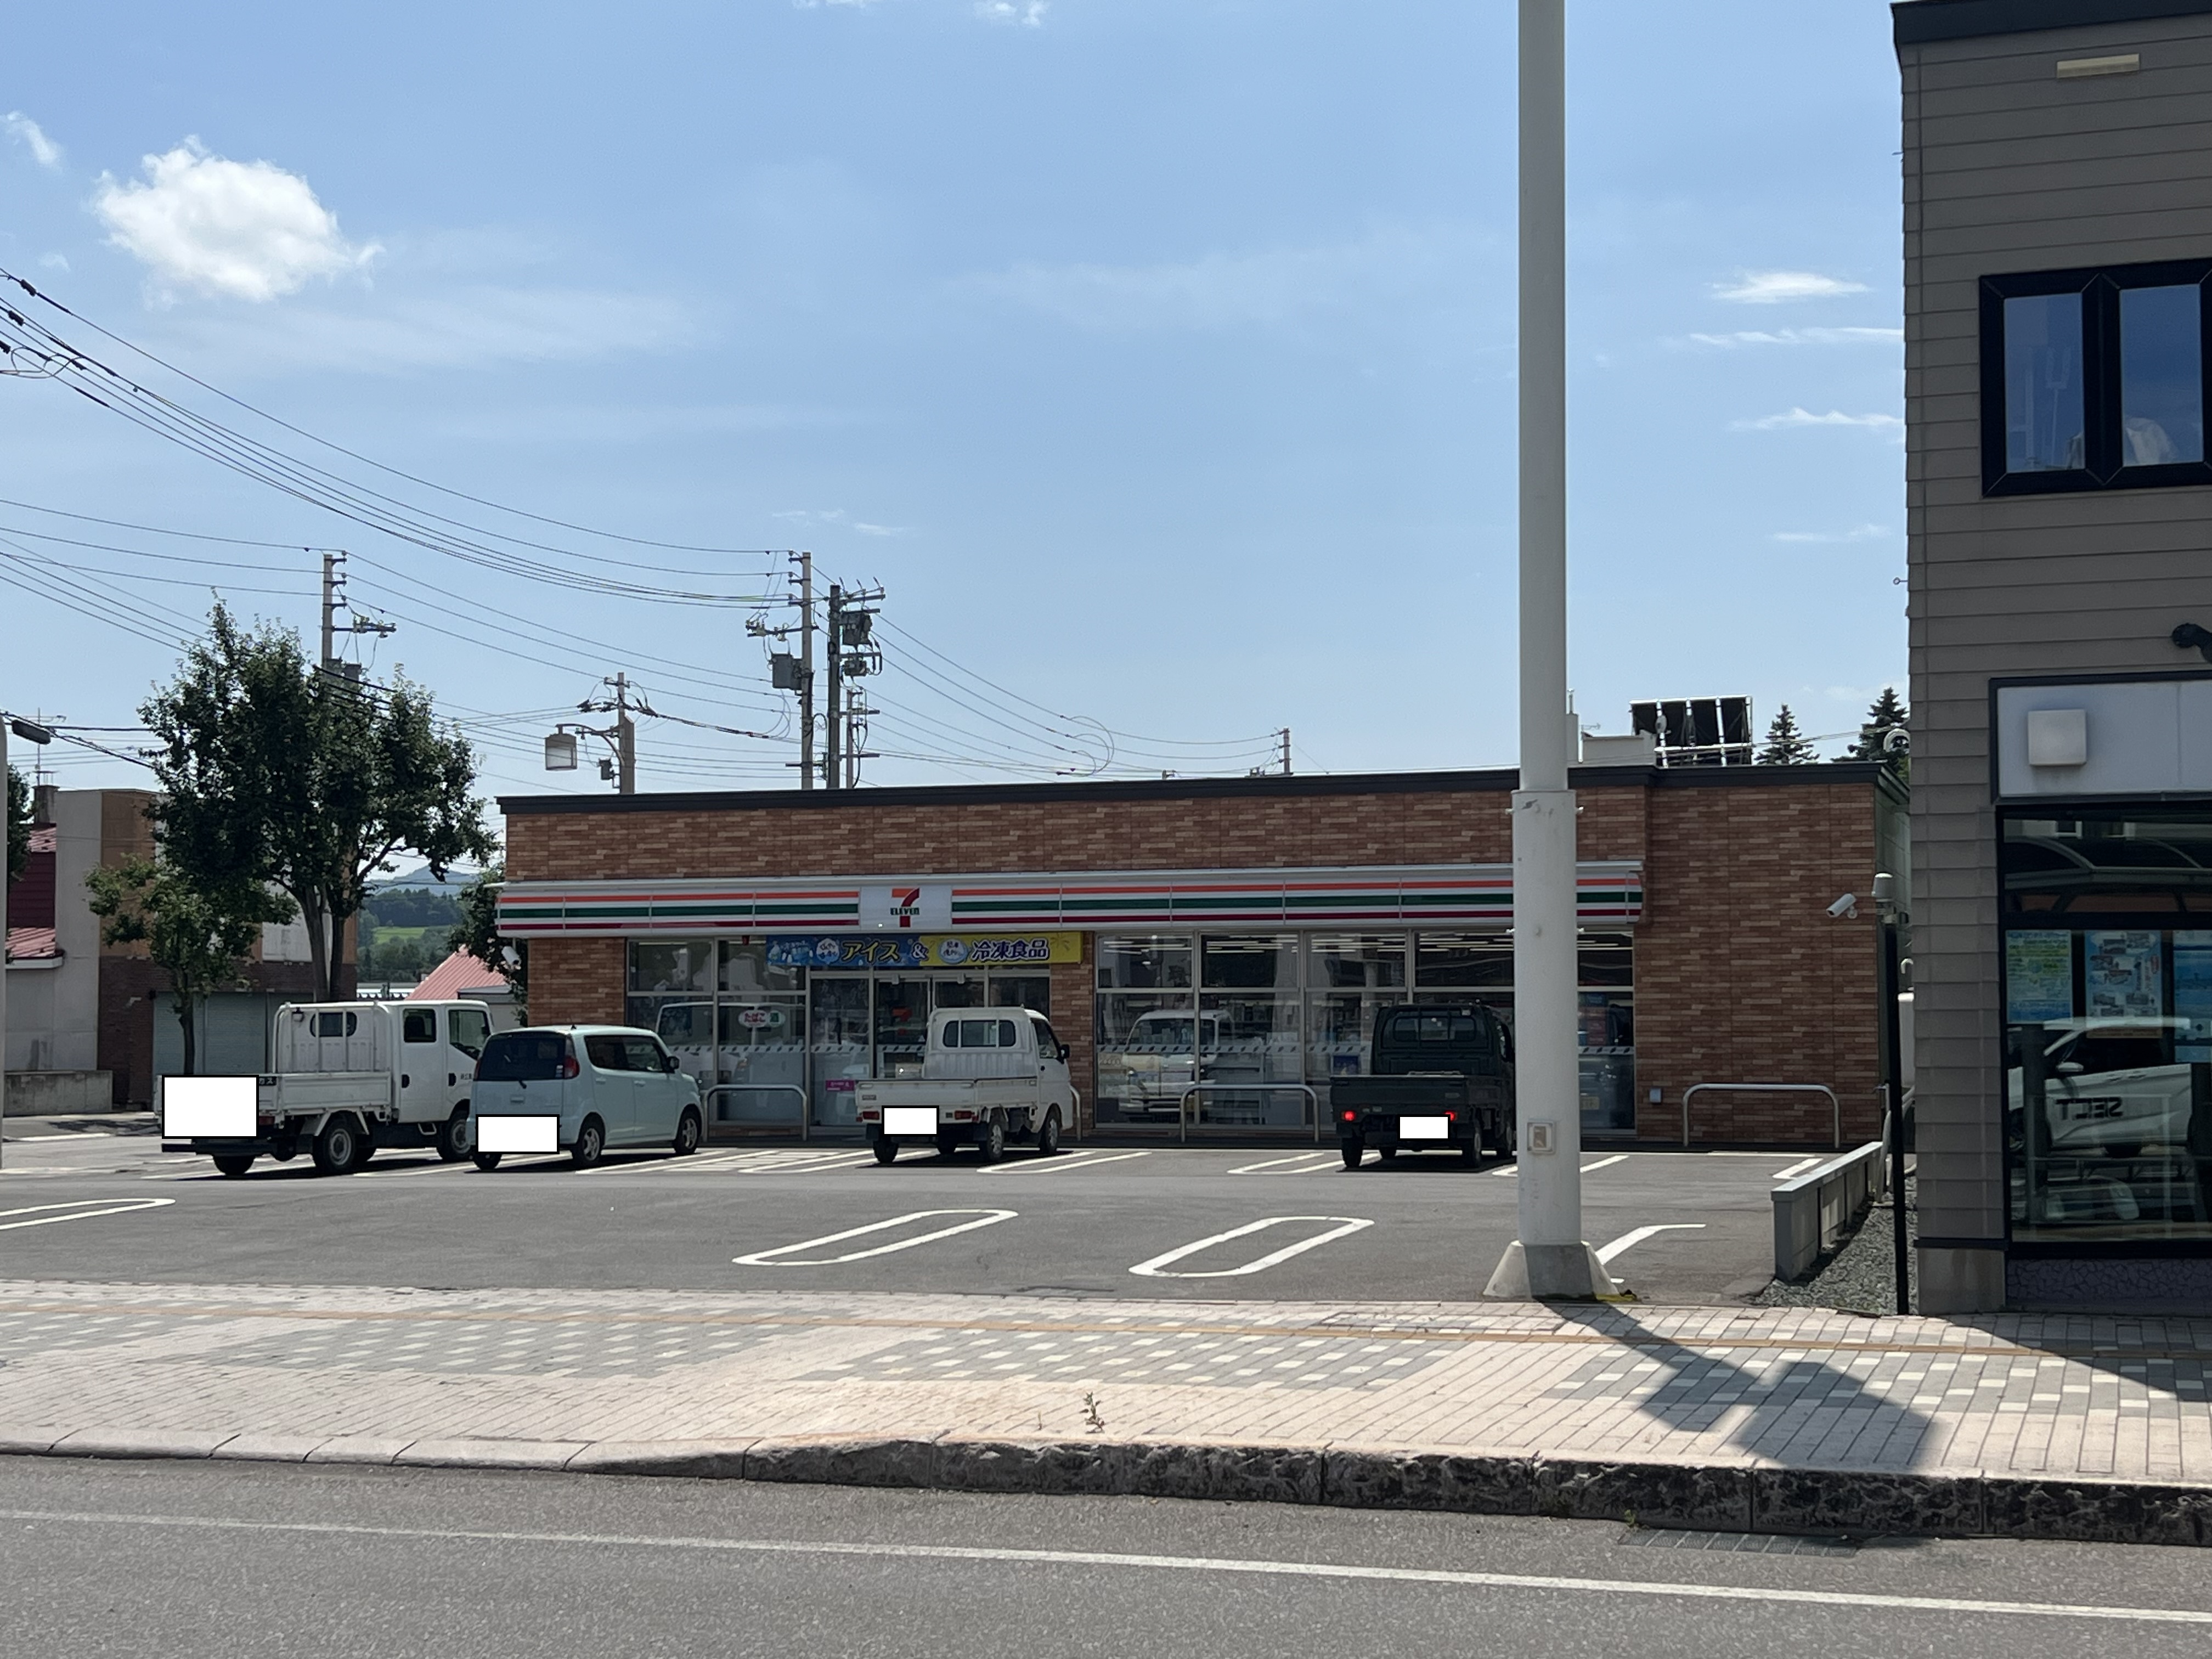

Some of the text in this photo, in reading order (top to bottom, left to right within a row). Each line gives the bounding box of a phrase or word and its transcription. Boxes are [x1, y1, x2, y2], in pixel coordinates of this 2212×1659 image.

[891, 888, 920, 927] 7
[842, 938, 900, 964] アイス
[912, 942, 928, 960] &
[972, 939, 1049, 962] 冷凍食品
